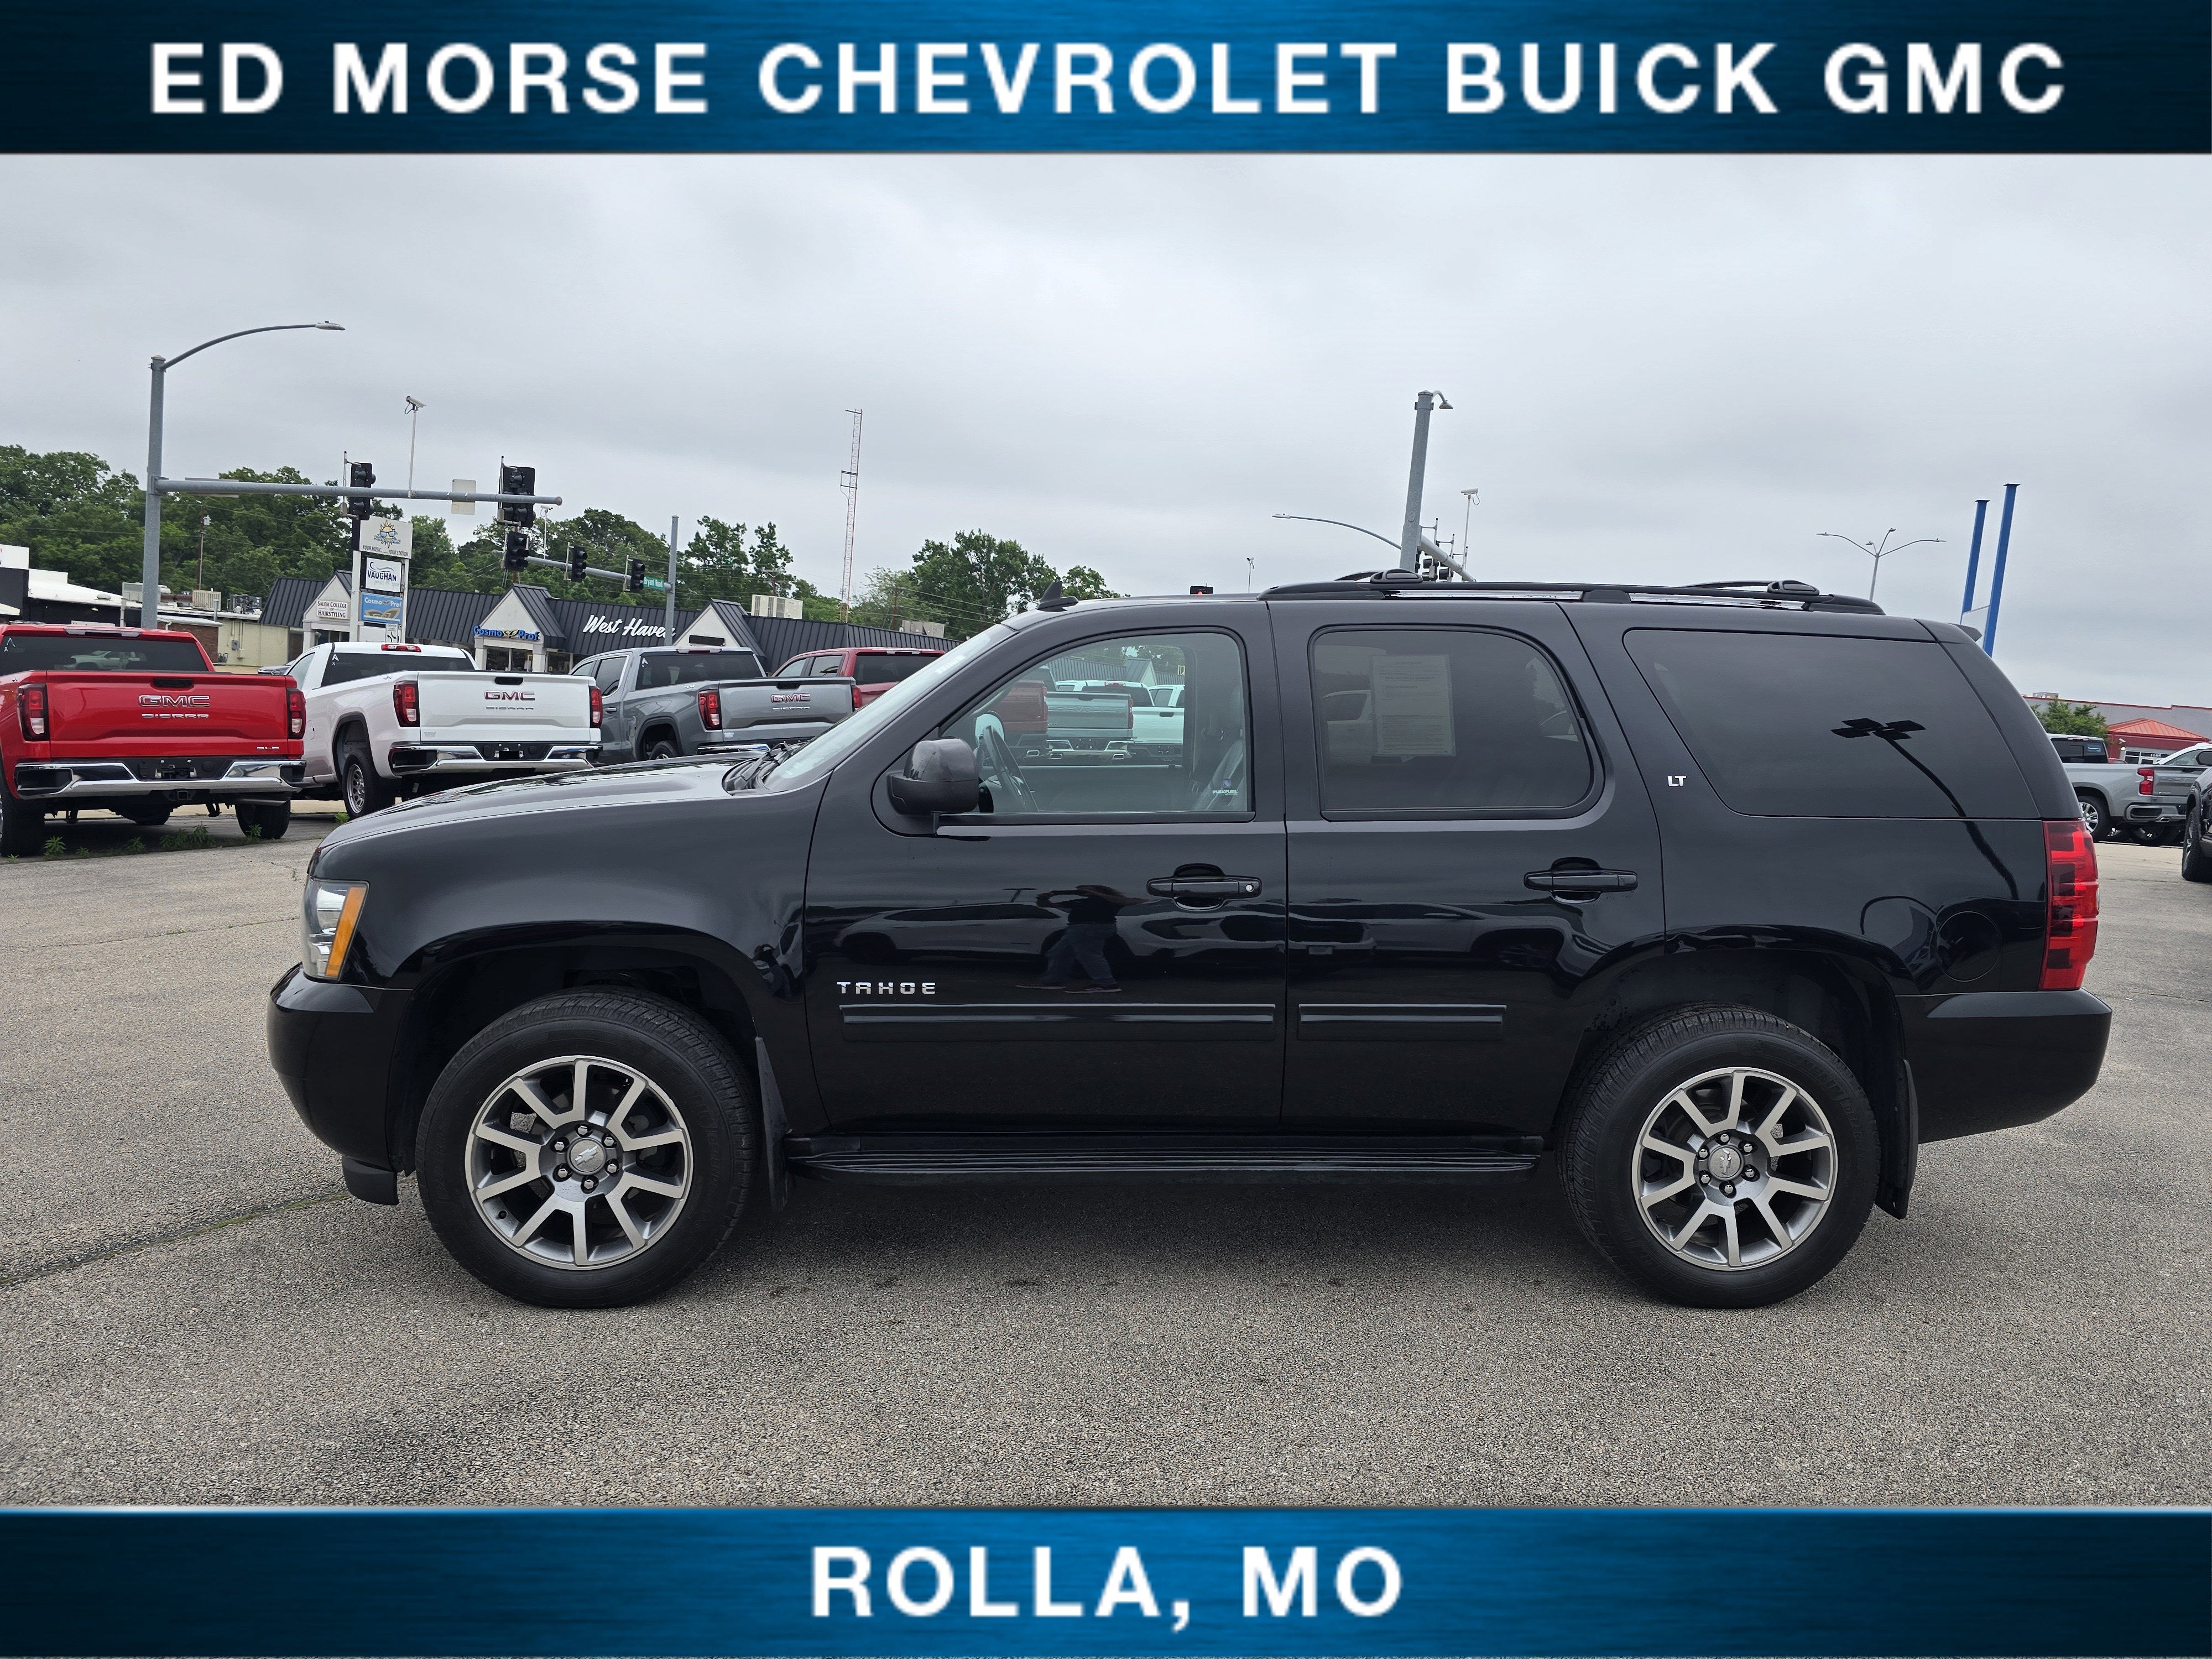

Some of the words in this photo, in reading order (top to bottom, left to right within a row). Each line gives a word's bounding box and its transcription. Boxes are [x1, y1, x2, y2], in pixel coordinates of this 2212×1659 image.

[368, 570, 397, 581] VAUGHAN
[655, 579, 663, 588] Road
[582, 614, 623, 634] West
[473, 625, 504, 637] Cosmo
[518, 629, 540, 640] Prof
[139, 695, 210, 707] GMC
[484, 690, 535, 701] GMC
[771, 693, 811, 703] GMC
[1667, 775, 1687, 786] LT
[837, 982, 936, 994] TAHOE
